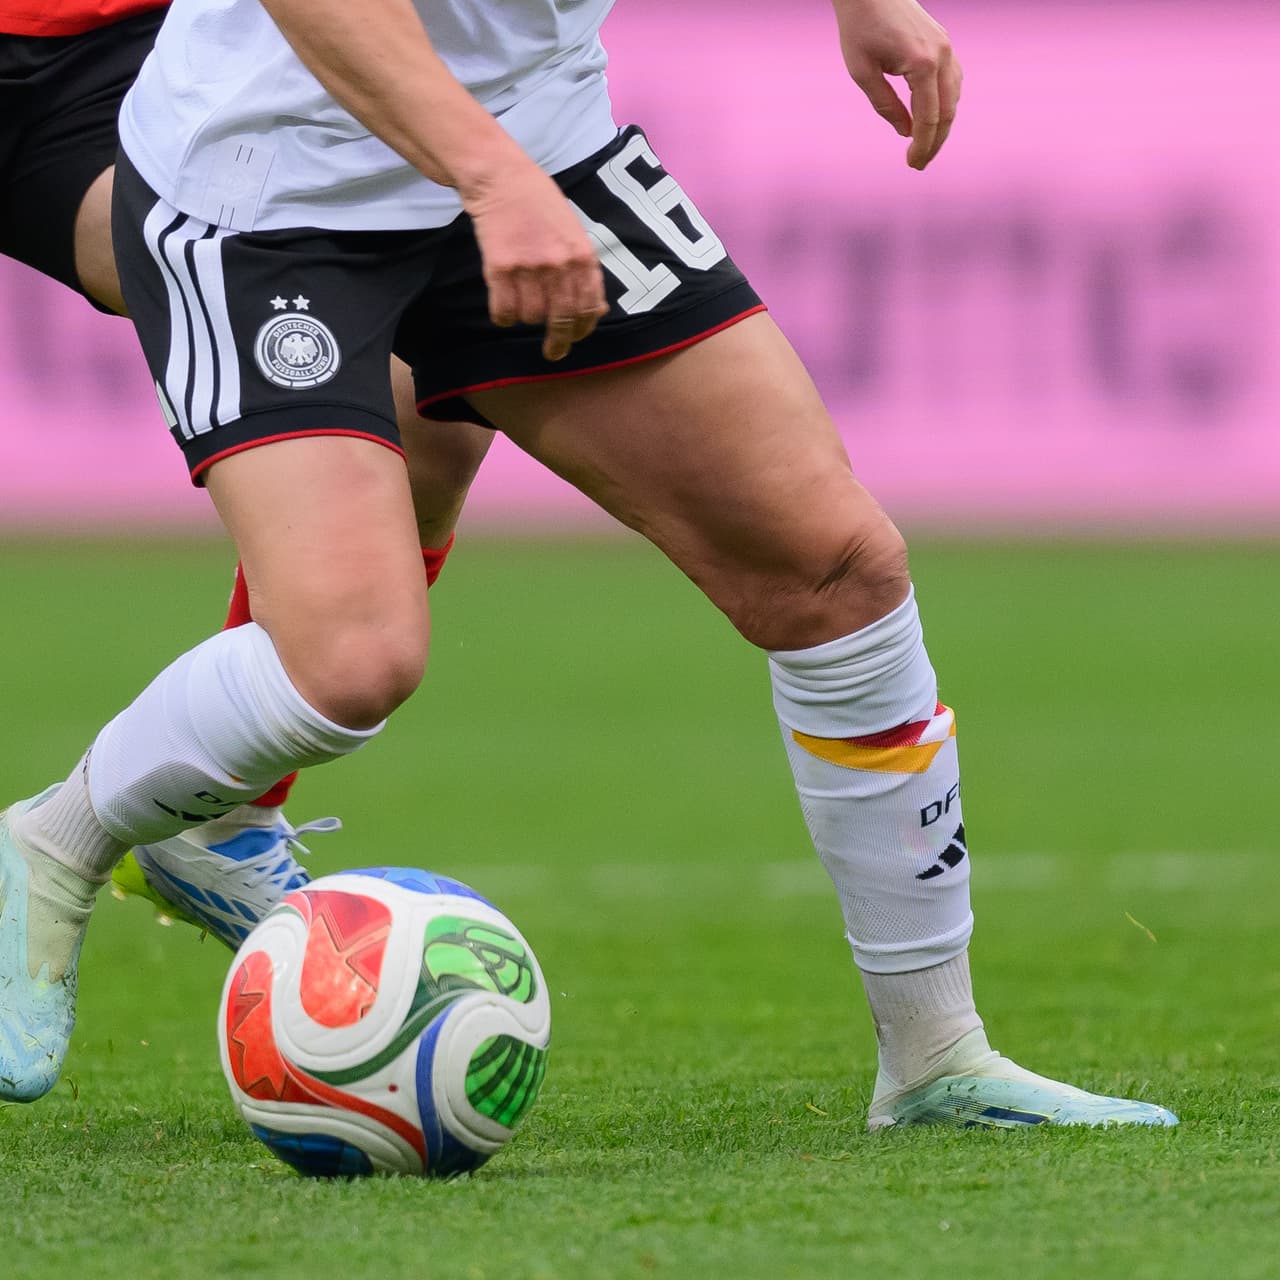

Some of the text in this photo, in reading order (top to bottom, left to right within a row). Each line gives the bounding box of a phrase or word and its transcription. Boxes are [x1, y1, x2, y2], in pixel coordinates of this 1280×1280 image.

[567, 132, 729, 316] 16
[272, 321, 321, 338] DEUTSCHER
[271, 355, 329, 377] FUSSBALL-BUND
[920, 777, 961, 829] DF
